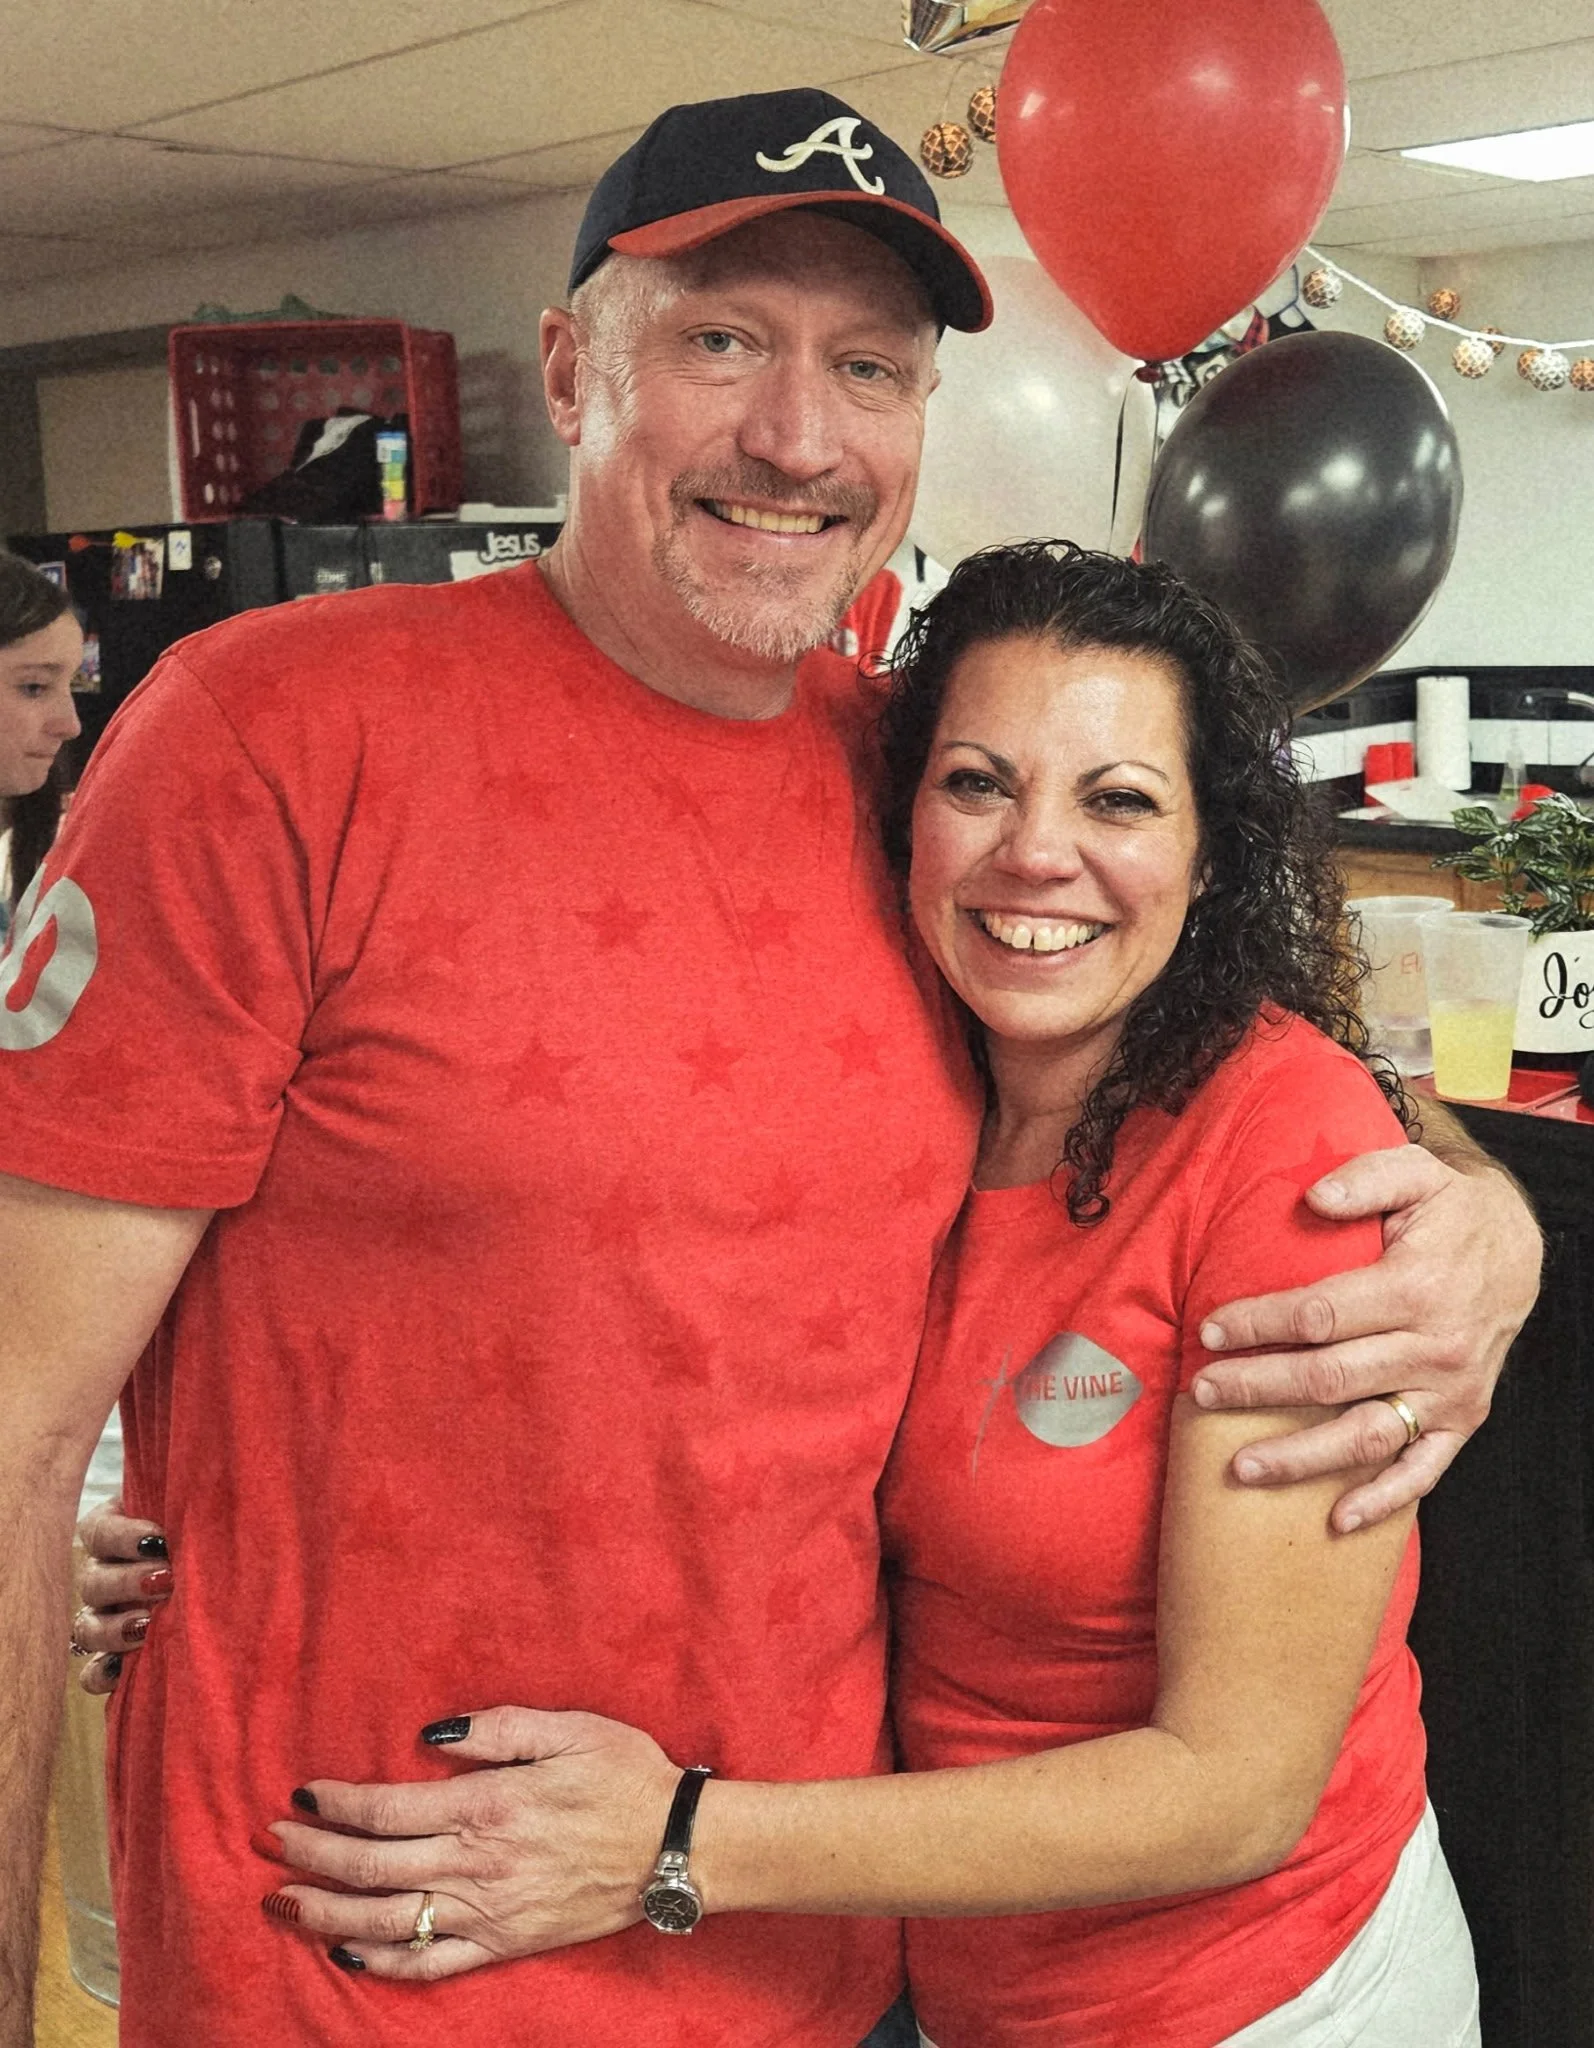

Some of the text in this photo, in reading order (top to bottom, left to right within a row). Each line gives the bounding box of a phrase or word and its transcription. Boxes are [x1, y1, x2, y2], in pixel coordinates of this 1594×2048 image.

[756, 116, 886, 196] A
[480, 531, 541, 562] Jesus
[1539, 952, 1594, 1030] Jo
[1063, 1371, 1124, 1401] VINE
